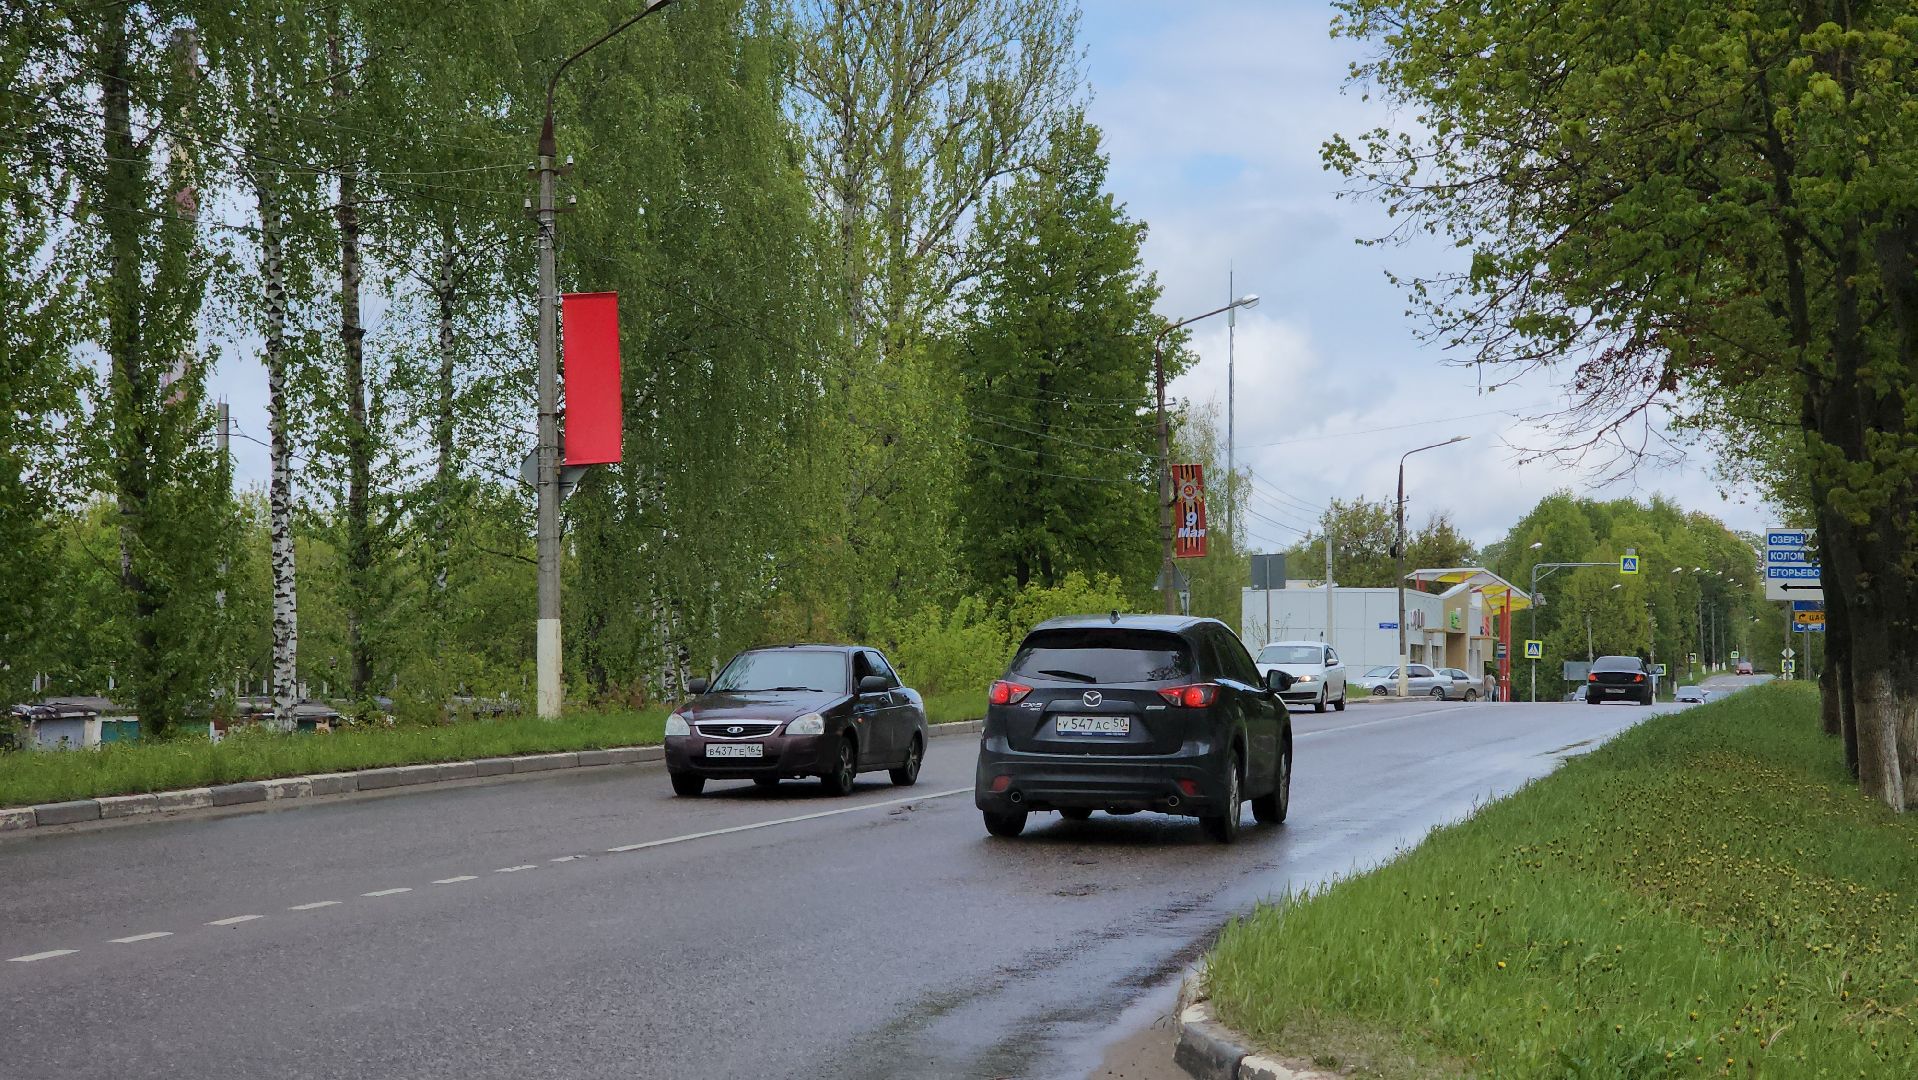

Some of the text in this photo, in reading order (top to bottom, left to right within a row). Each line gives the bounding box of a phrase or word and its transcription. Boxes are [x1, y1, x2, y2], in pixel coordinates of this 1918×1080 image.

[1186, 512, 1198, 527] 9
[1771, 535, 1804, 544] ОЗЕРЫ
[1770, 551, 1819, 561] КОЛОМ
[1770, 568, 1820, 577] ЕГОРЬЕВС
